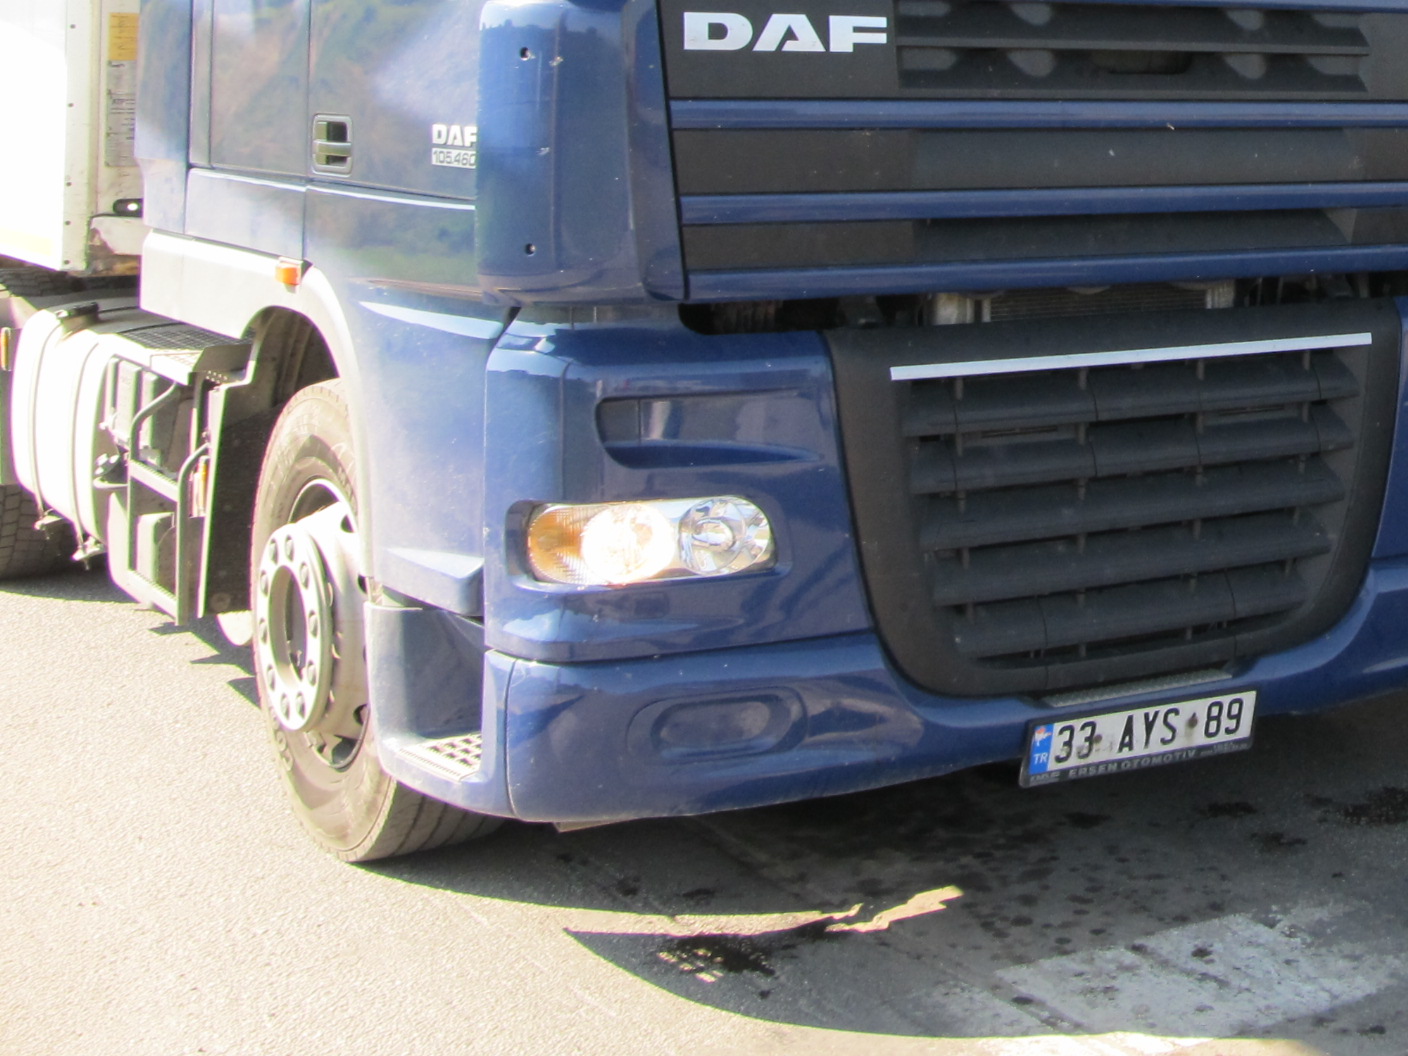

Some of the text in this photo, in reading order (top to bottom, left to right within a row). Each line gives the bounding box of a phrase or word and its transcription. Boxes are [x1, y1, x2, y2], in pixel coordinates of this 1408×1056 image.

[683, 12, 887, 53] DAF
[431, 123, 478, 147] DAF
[1054, 698, 1244, 763] 33 AYS 89
[1033, 752, 1049, 766] TR
[1068, 761, 1118, 779] ERSEN
[1120, 748, 1197, 770] OTOMOTIV
